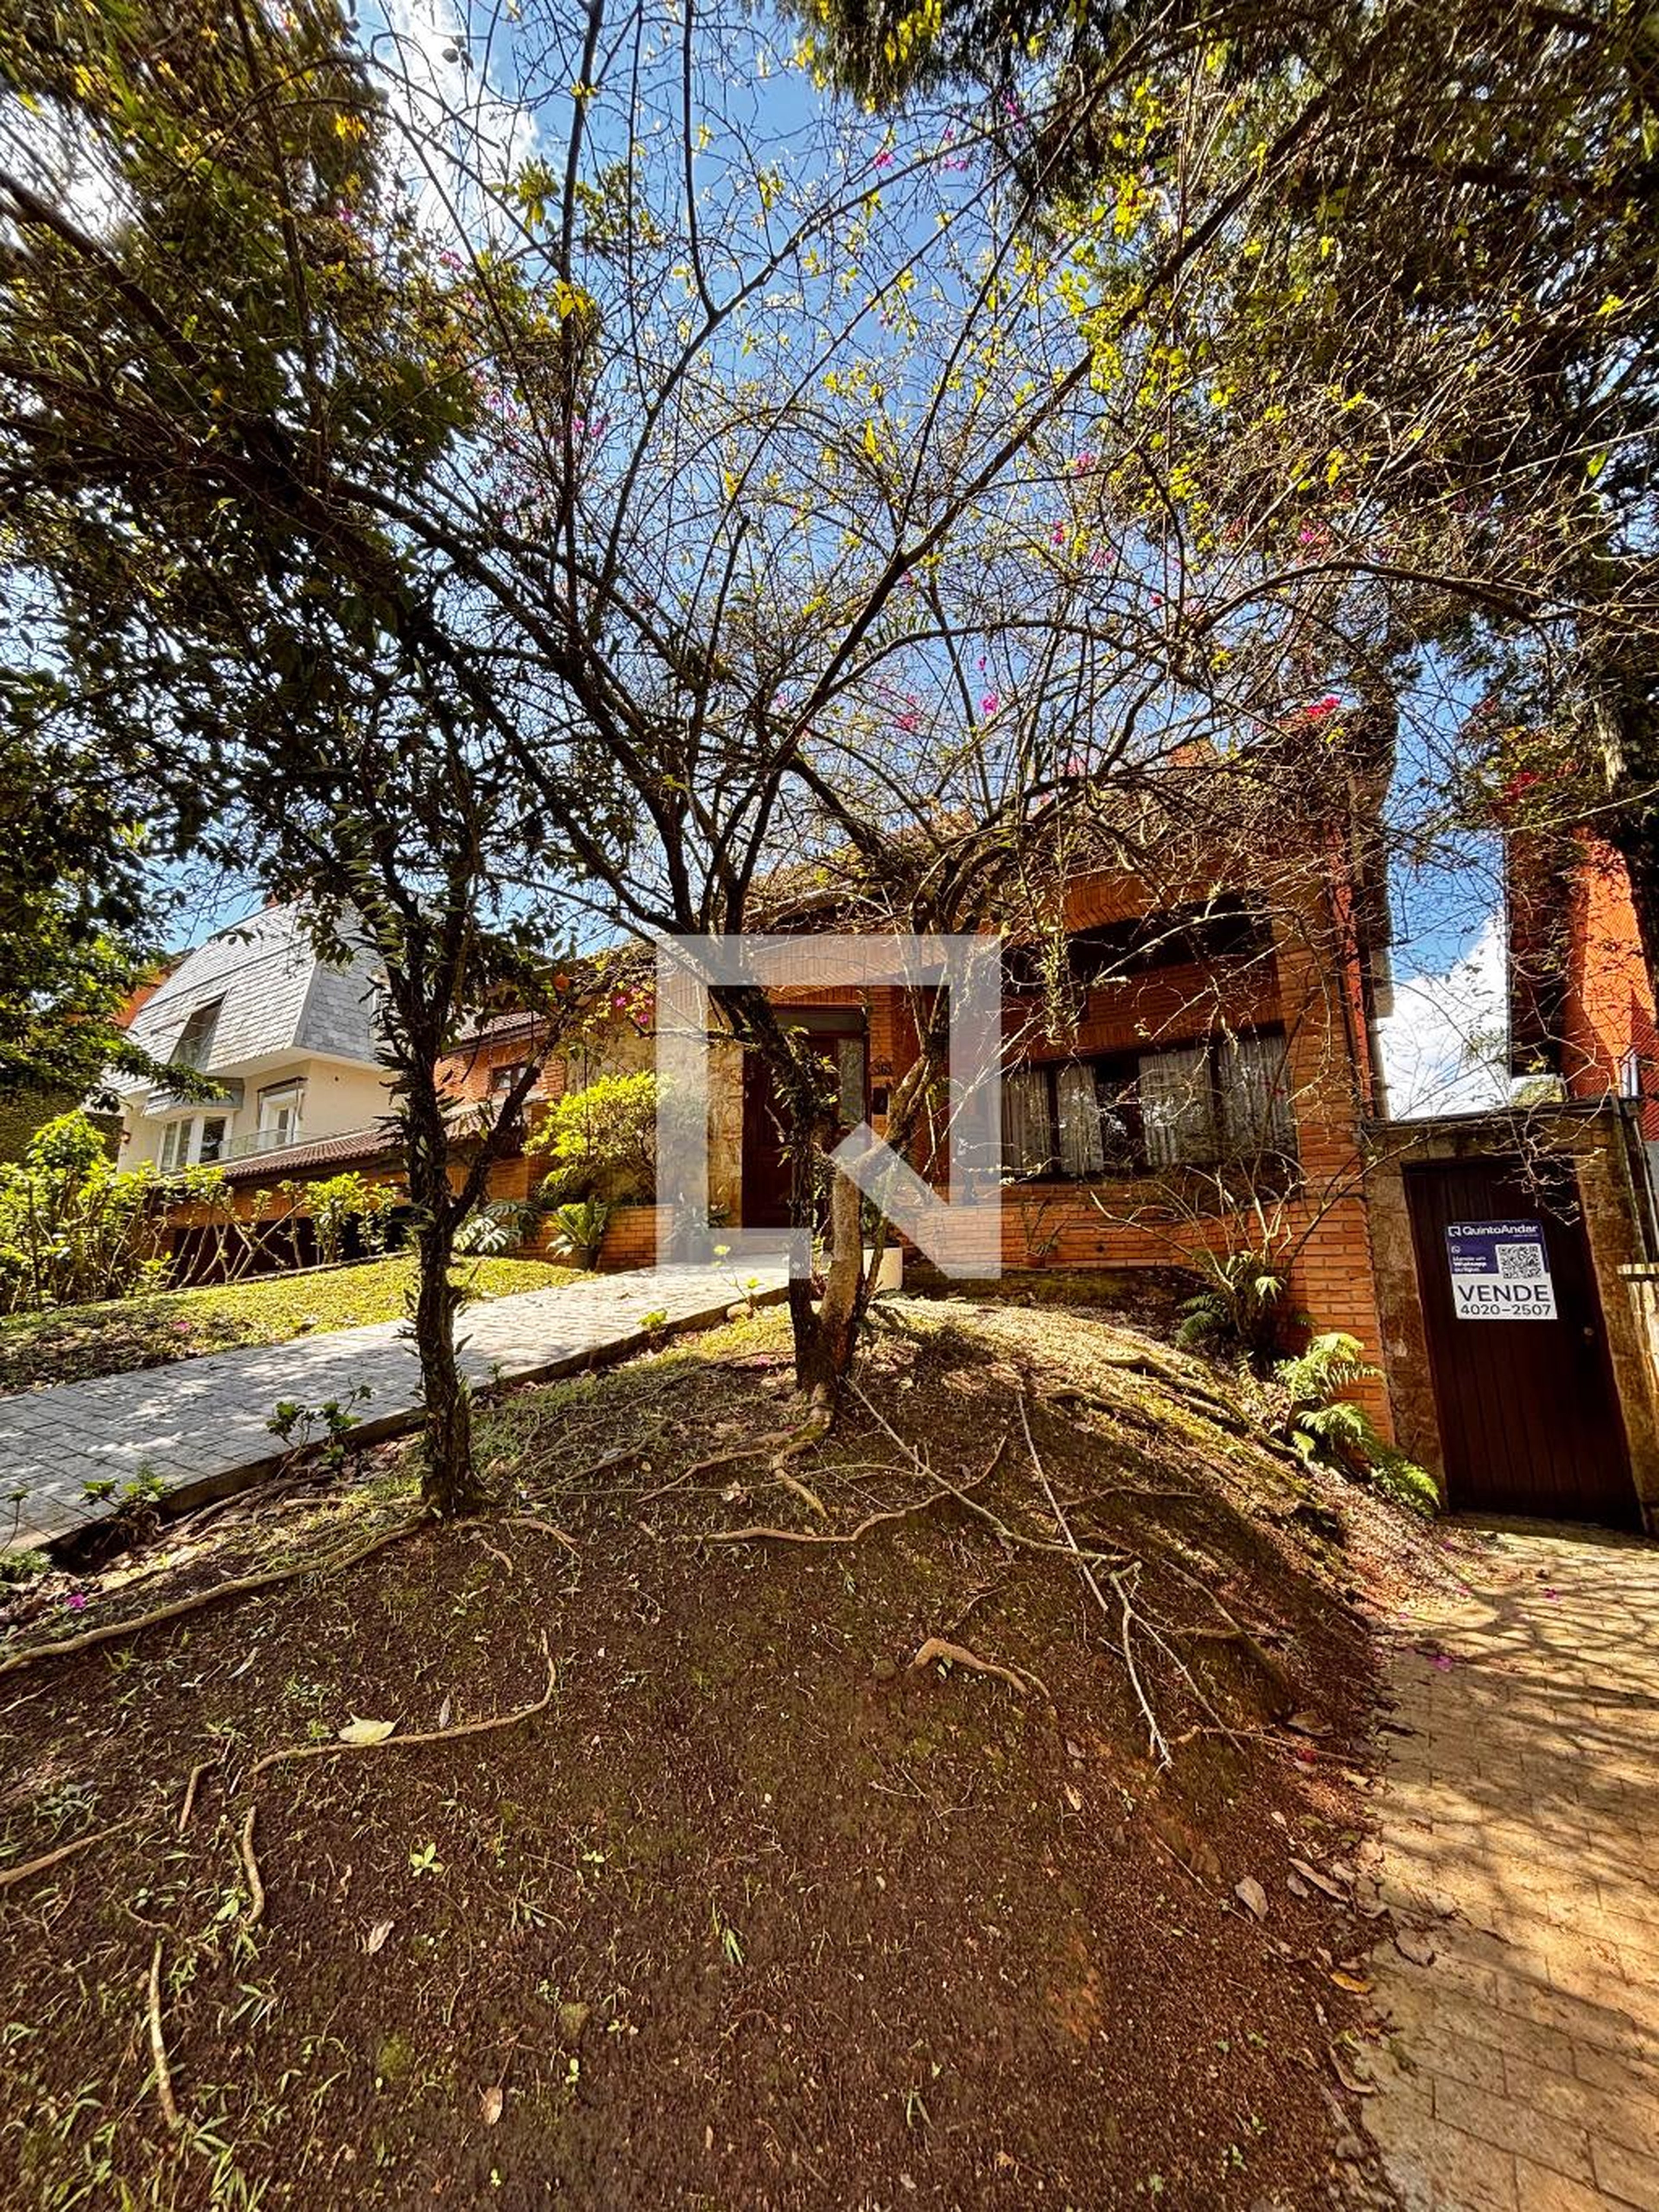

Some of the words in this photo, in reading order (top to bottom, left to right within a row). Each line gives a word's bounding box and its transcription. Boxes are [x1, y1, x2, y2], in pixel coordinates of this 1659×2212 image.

[1462, 1225, 1538, 1235] QuintoAndar
[1458, 1285, 1551, 1302] VENDE
[1461, 1304, 1551, 1315] 4020-2507
